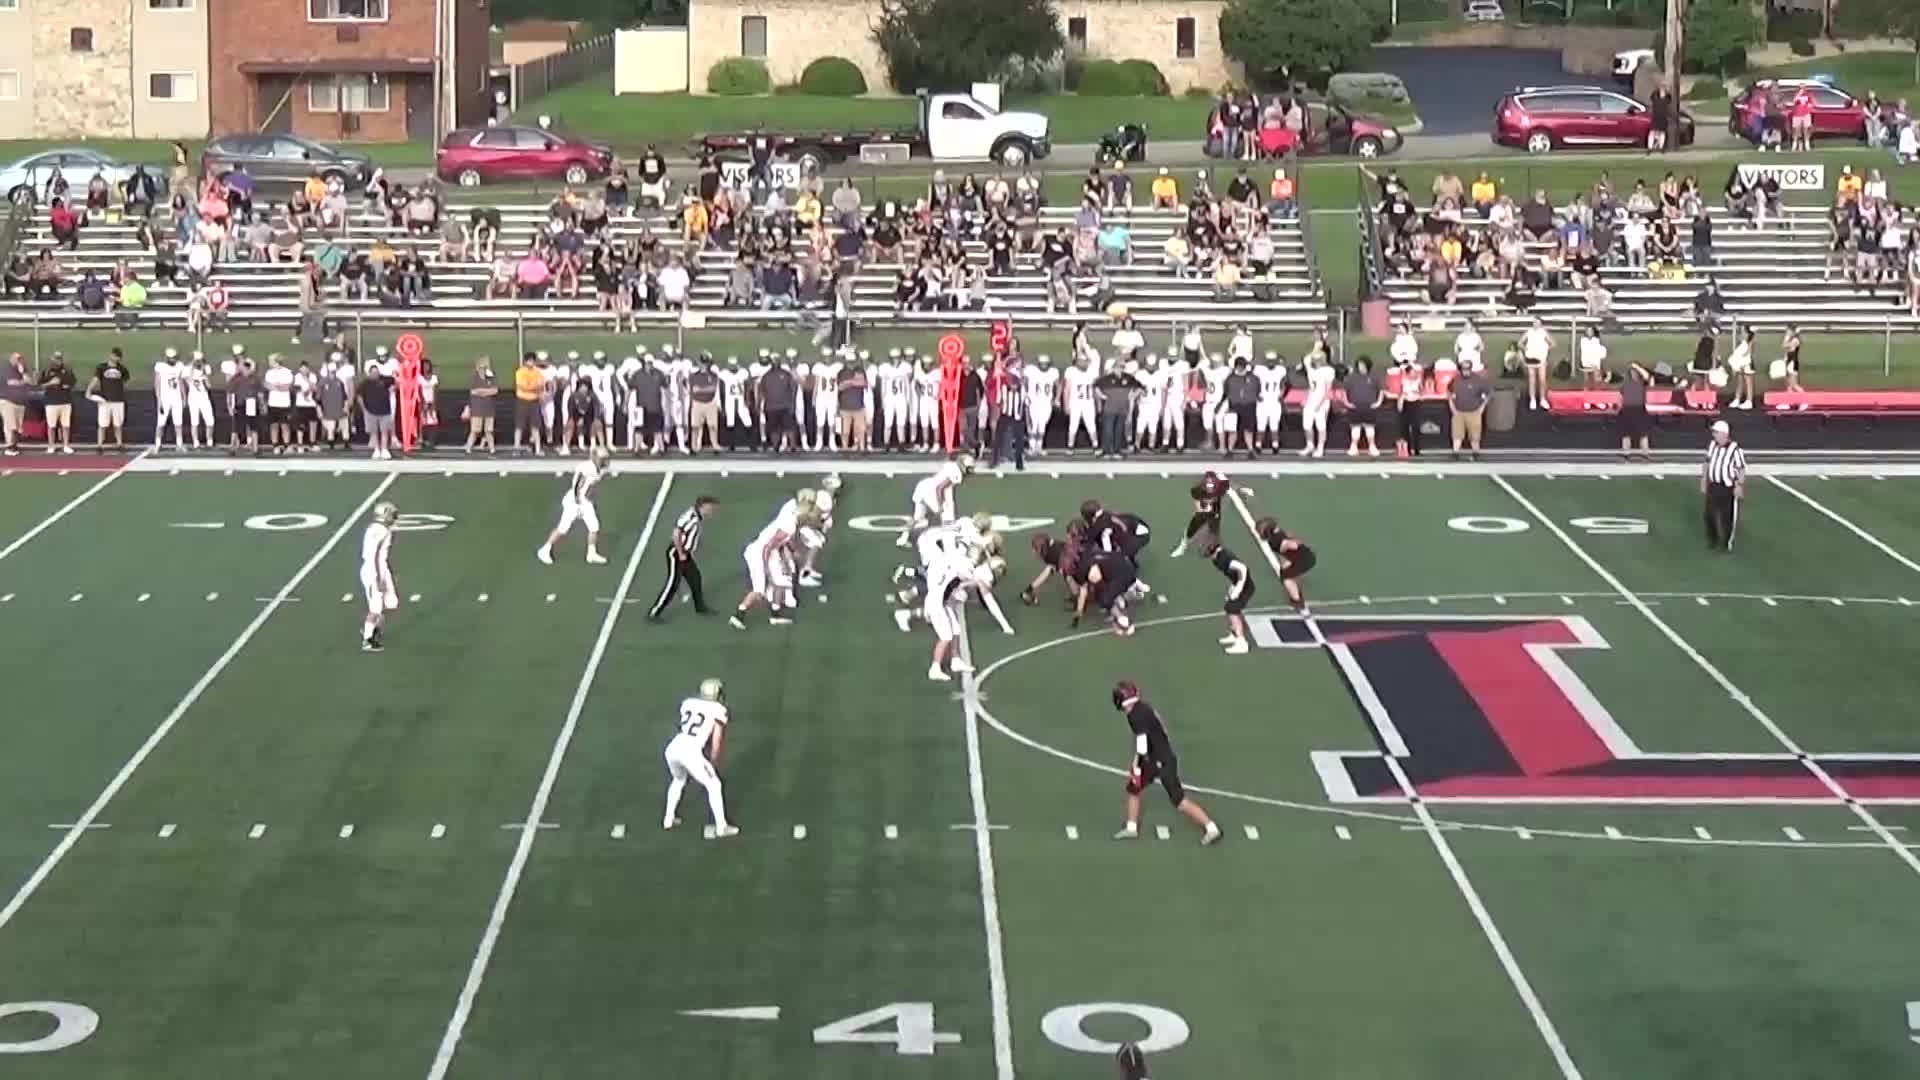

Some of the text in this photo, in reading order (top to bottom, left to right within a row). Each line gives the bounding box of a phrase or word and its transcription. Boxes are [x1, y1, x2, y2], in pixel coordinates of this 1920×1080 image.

[720, 167, 795, 184] VISIRS
[991, 324, 1007, 350] 2
[681, 709, 706, 737] 22
